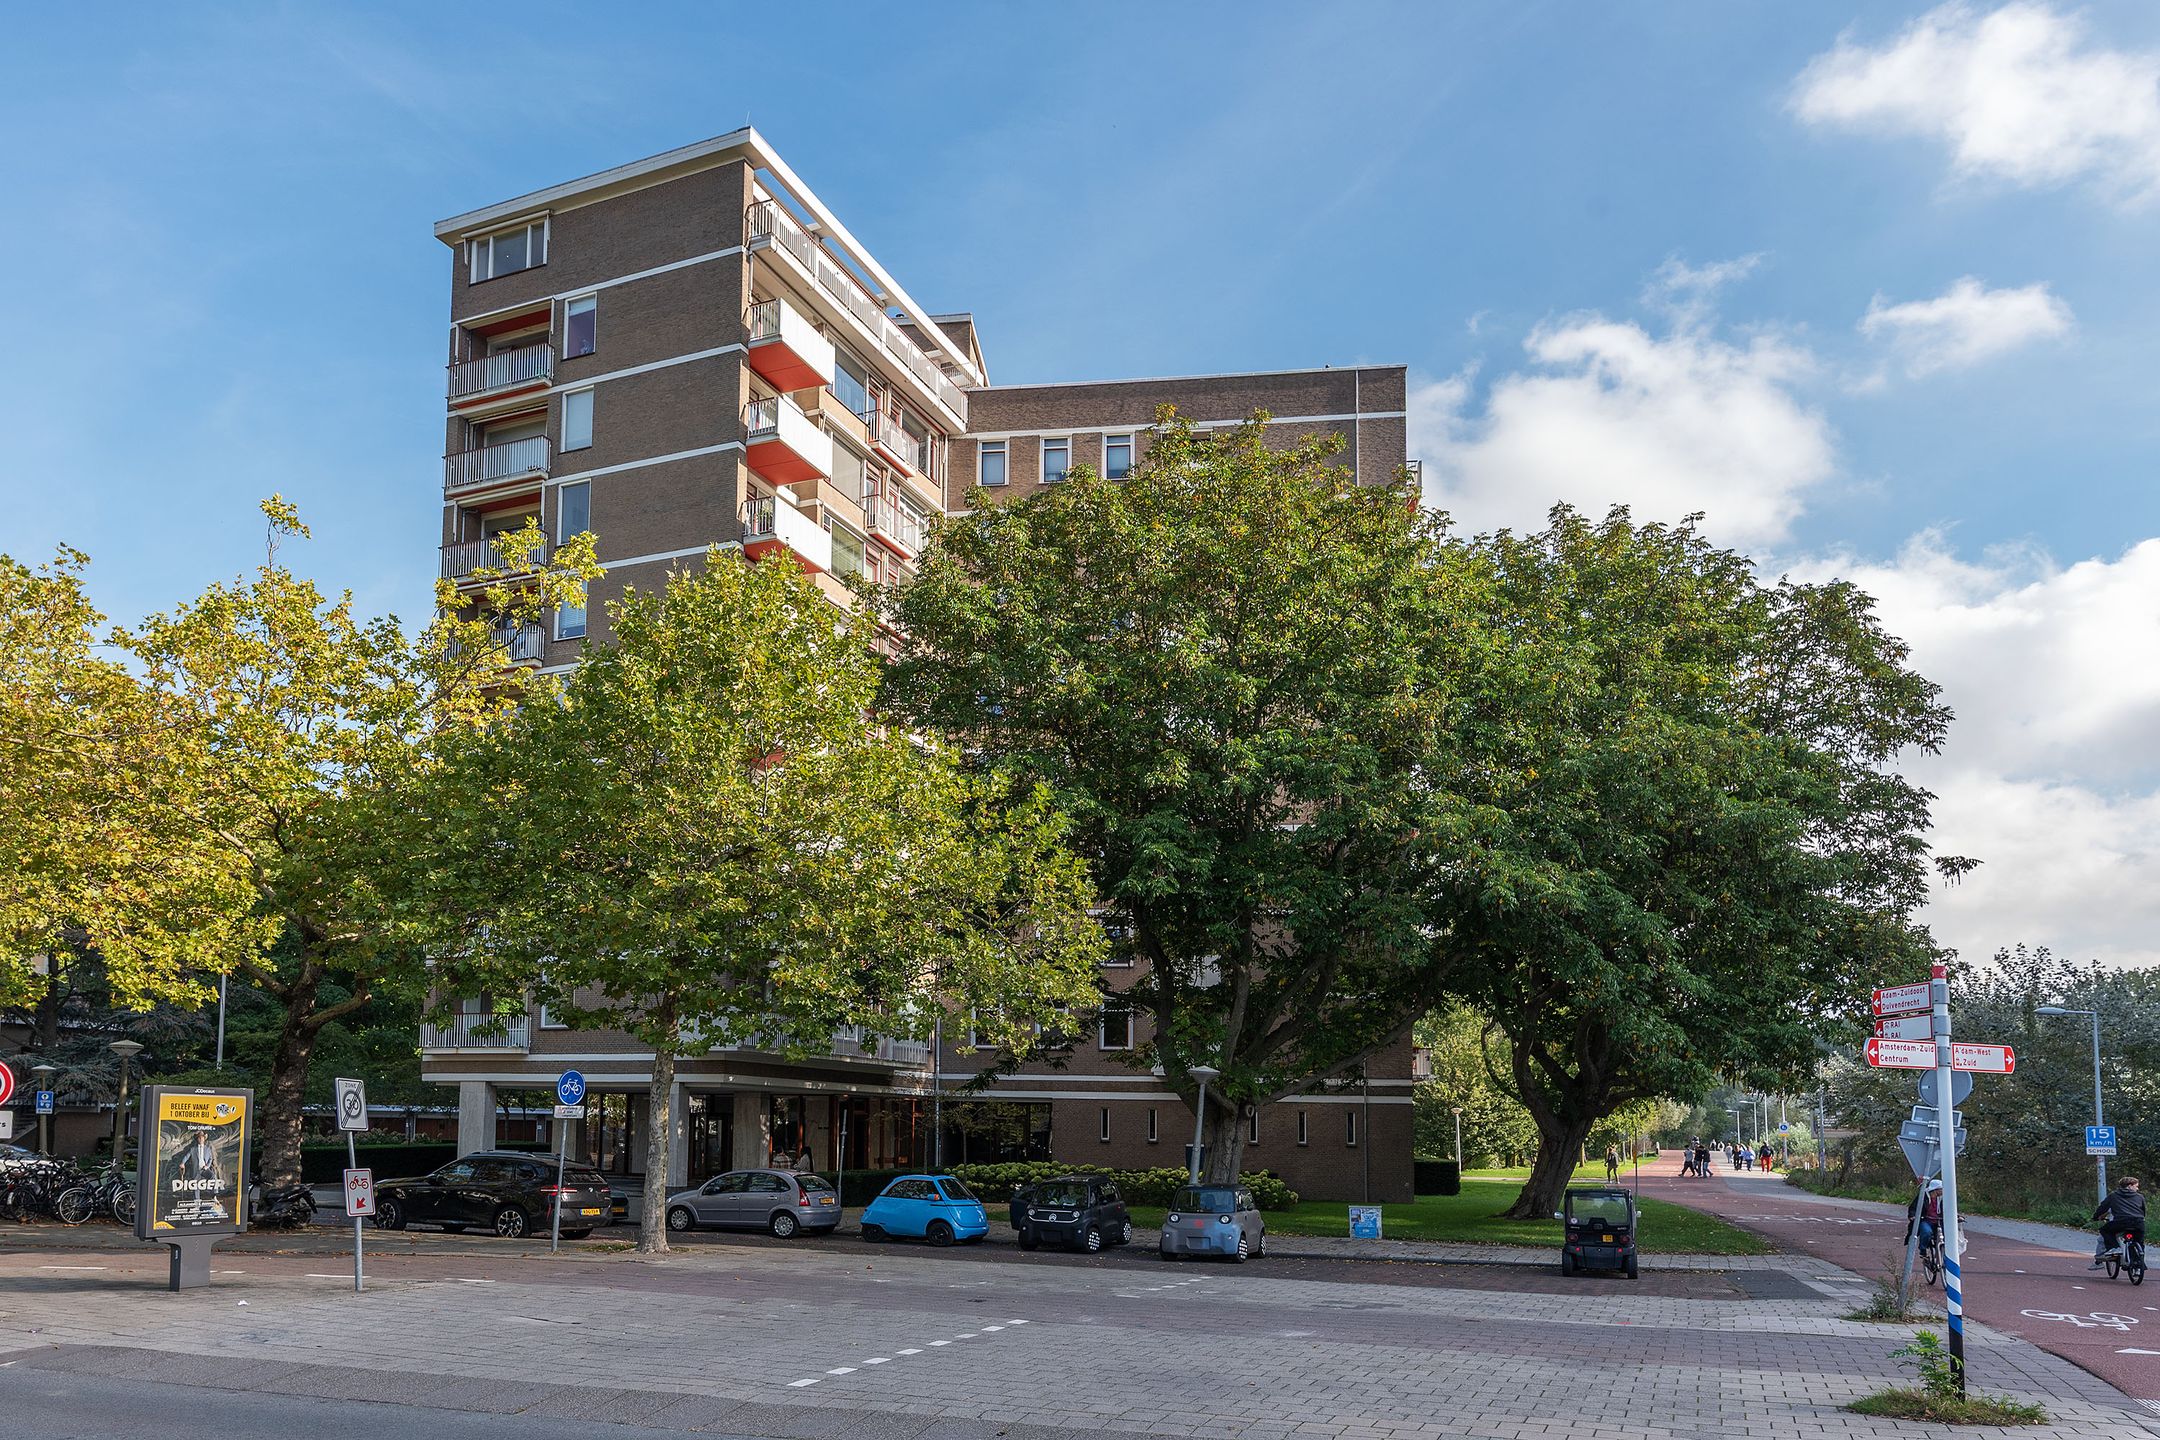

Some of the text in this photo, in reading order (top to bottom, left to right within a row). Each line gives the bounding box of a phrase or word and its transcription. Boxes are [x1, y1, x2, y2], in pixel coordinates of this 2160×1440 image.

[1882, 999, 1920, 1010] Duivendrecht
[1880, 1043, 1934, 1052] Amsterdam-Zuid
[1880, 1054, 1909, 1062] Centrum
[1963, 1058, 1977, 1066] Zuid
[346, 1099, 359, 1110] 30
[2091, 1129, 2110, 1139] 15
[172, 1179, 226, 1192] DIGGER
